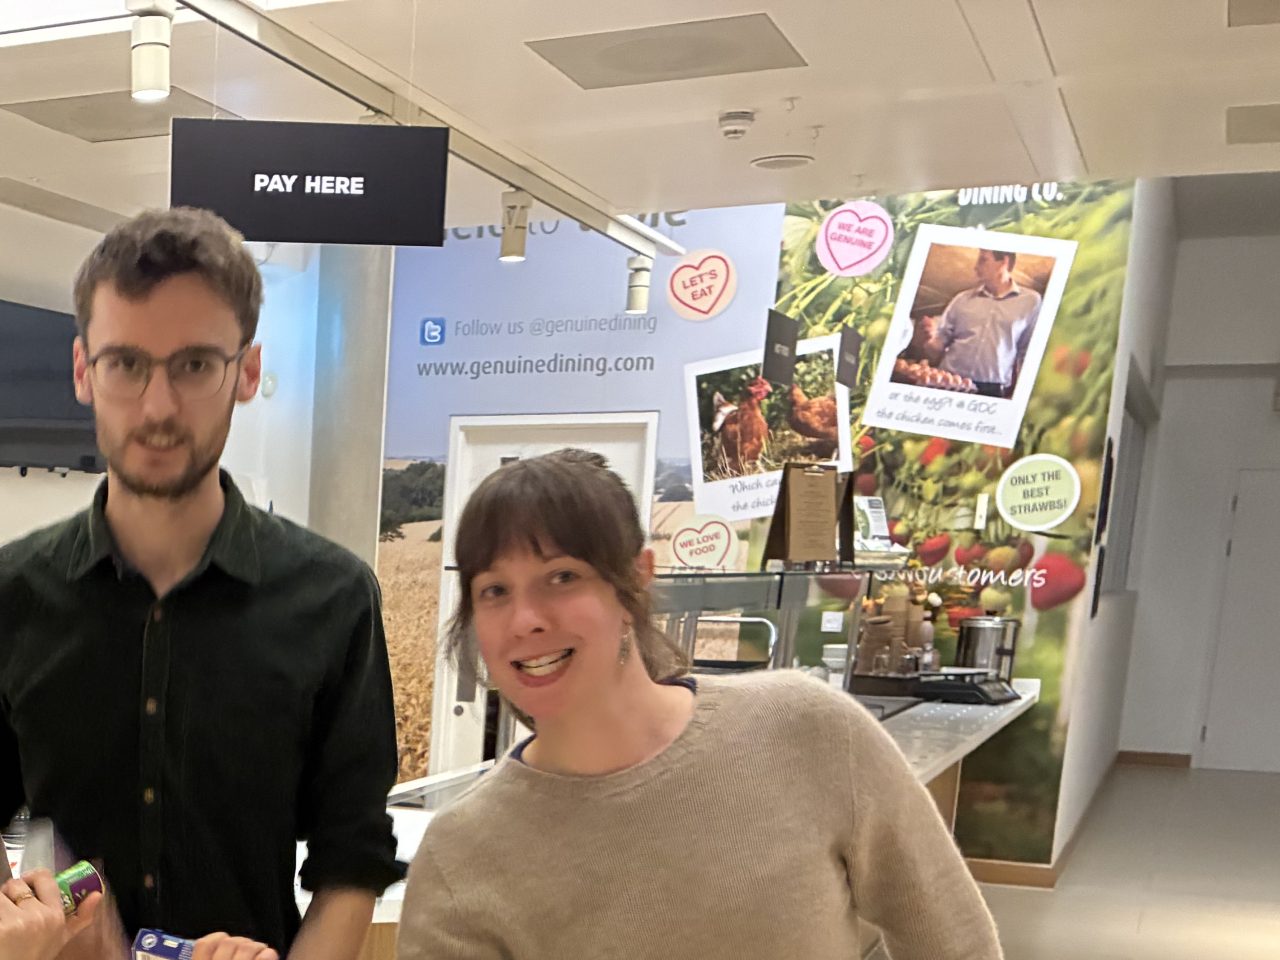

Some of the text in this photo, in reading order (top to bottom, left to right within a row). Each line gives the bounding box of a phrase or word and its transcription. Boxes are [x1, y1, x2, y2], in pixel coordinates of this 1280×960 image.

[254, 173, 364, 195] PAY HERE
[838, 222, 875, 237] WE ARE
[830, 232, 875, 249] GENUINE
[682, 268, 718, 290] LET'S
[691, 284, 715, 301] EAT
[454, 314, 658, 338] Follow us @genuinedining
[417, 353, 655, 380] www.genuinedining.com
[876, 407, 894, 419] the
[895, 411, 934, 425] chicken
[937, 419, 972, 431] comes
[729, 479, 763, 494] Which
[1010, 470, 1061, 486] ONLY THE
[1023, 486, 1050, 499] BEST
[731, 500, 748, 512] the
[1010, 498, 1067, 516] STRAWBS!
[680, 531, 721, 549] WE LOVE
[689, 544, 716, 557] FOOD
